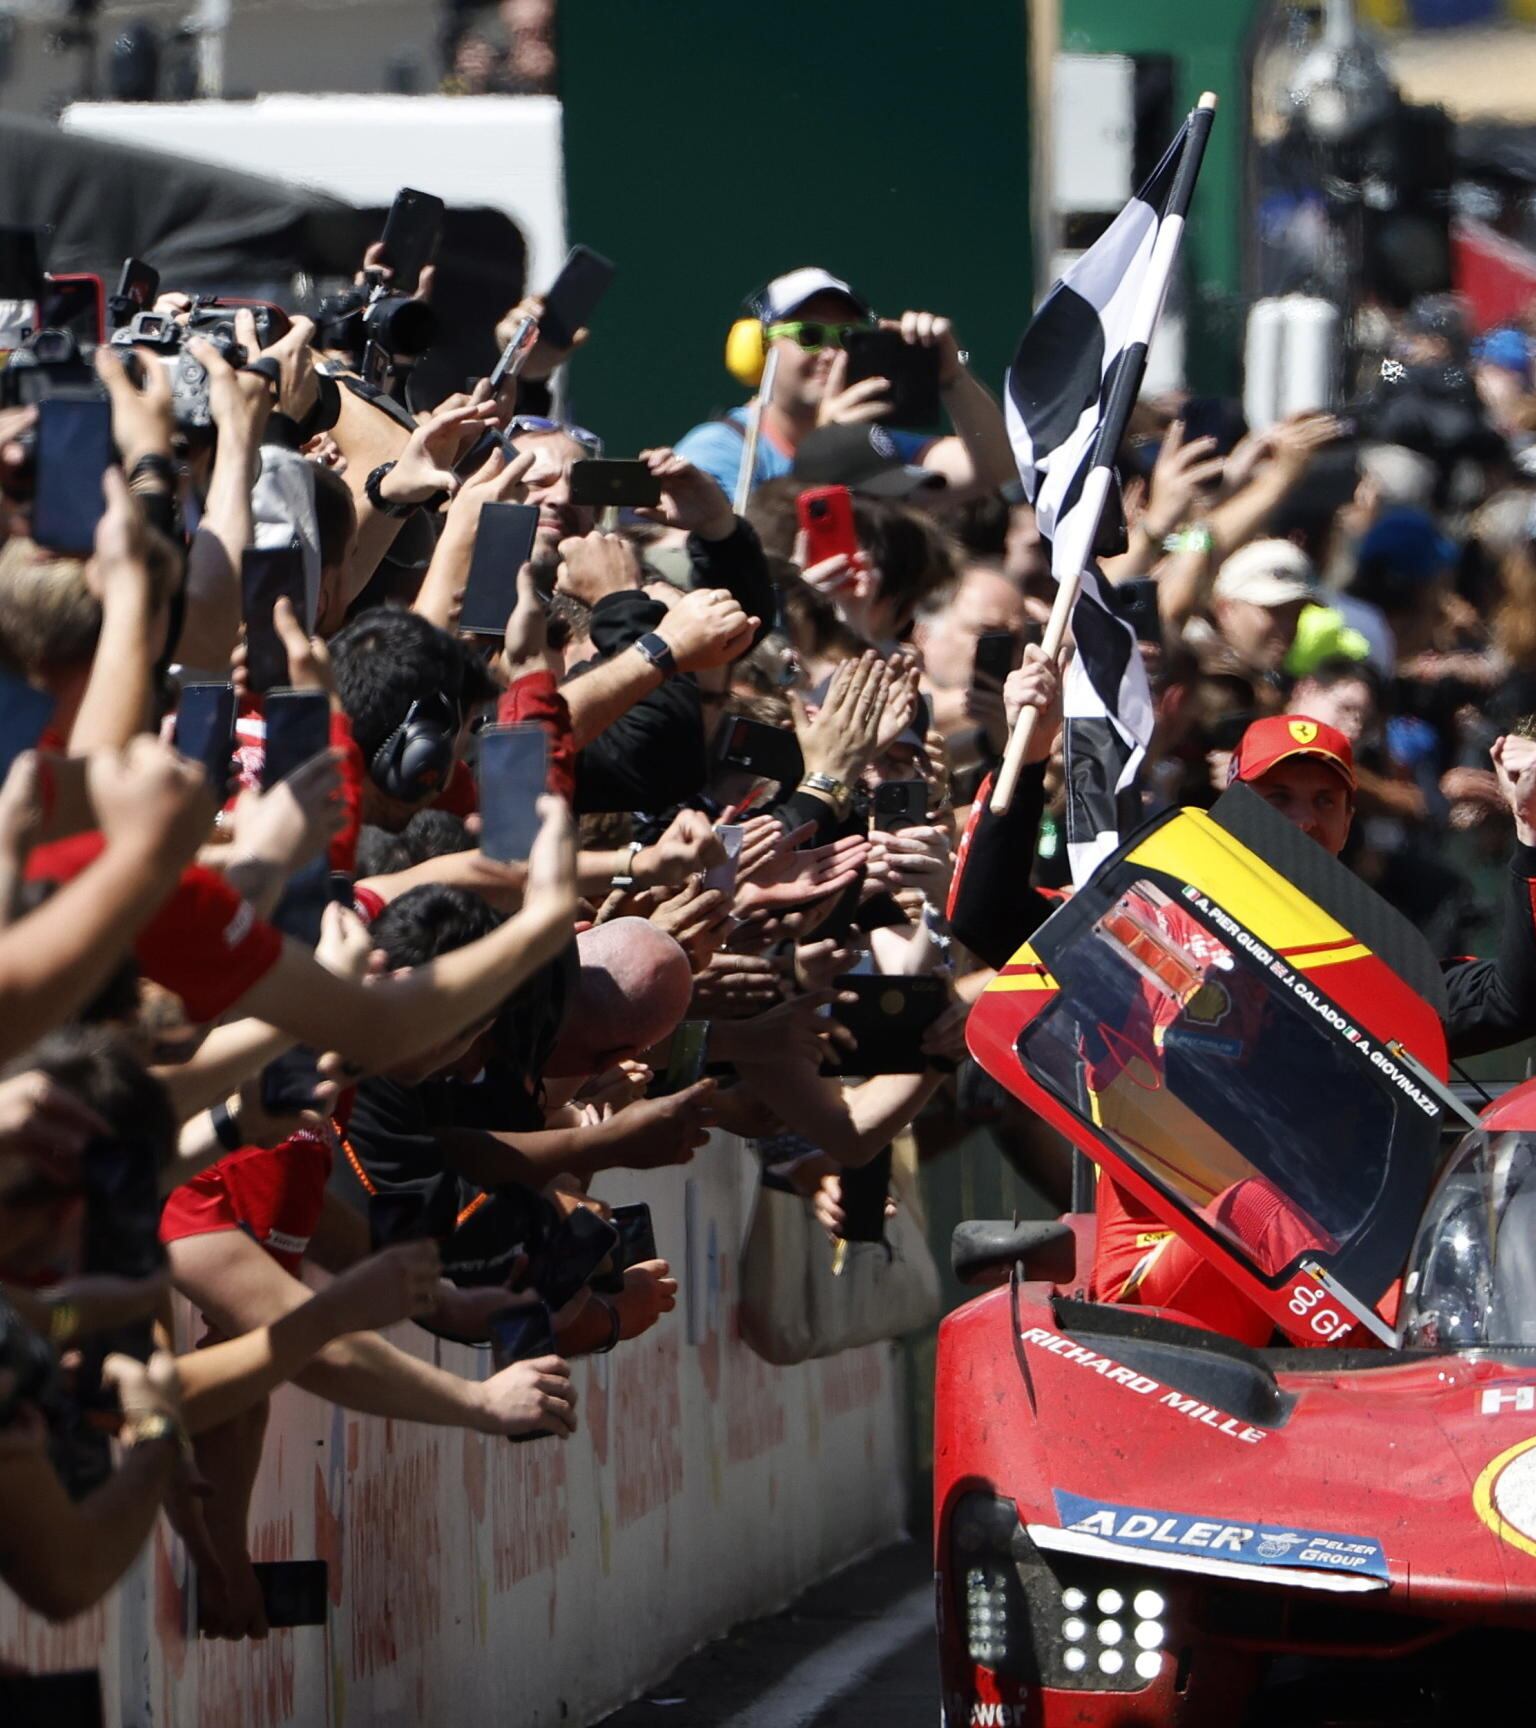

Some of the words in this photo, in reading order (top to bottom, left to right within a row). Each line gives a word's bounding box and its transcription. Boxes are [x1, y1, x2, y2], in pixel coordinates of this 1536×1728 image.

[1195, 898, 1210, 913] A.
[1283, 975, 1296, 987] J.
[1294, 983, 1347, 1030] CALADO
[1355, 1040, 1370, 1055] A.
[1370, 1051, 1439, 1116] GIOVINAZZI
[1021, 1327, 1159, 1394] RICHARD
[1159, 1391, 1267, 1444] MILLE
[1067, 1510, 1255, 1552] ADLER
[1308, 1537, 1377, 1556] PELZER
[1299, 1549, 1367, 1567] GROUP
